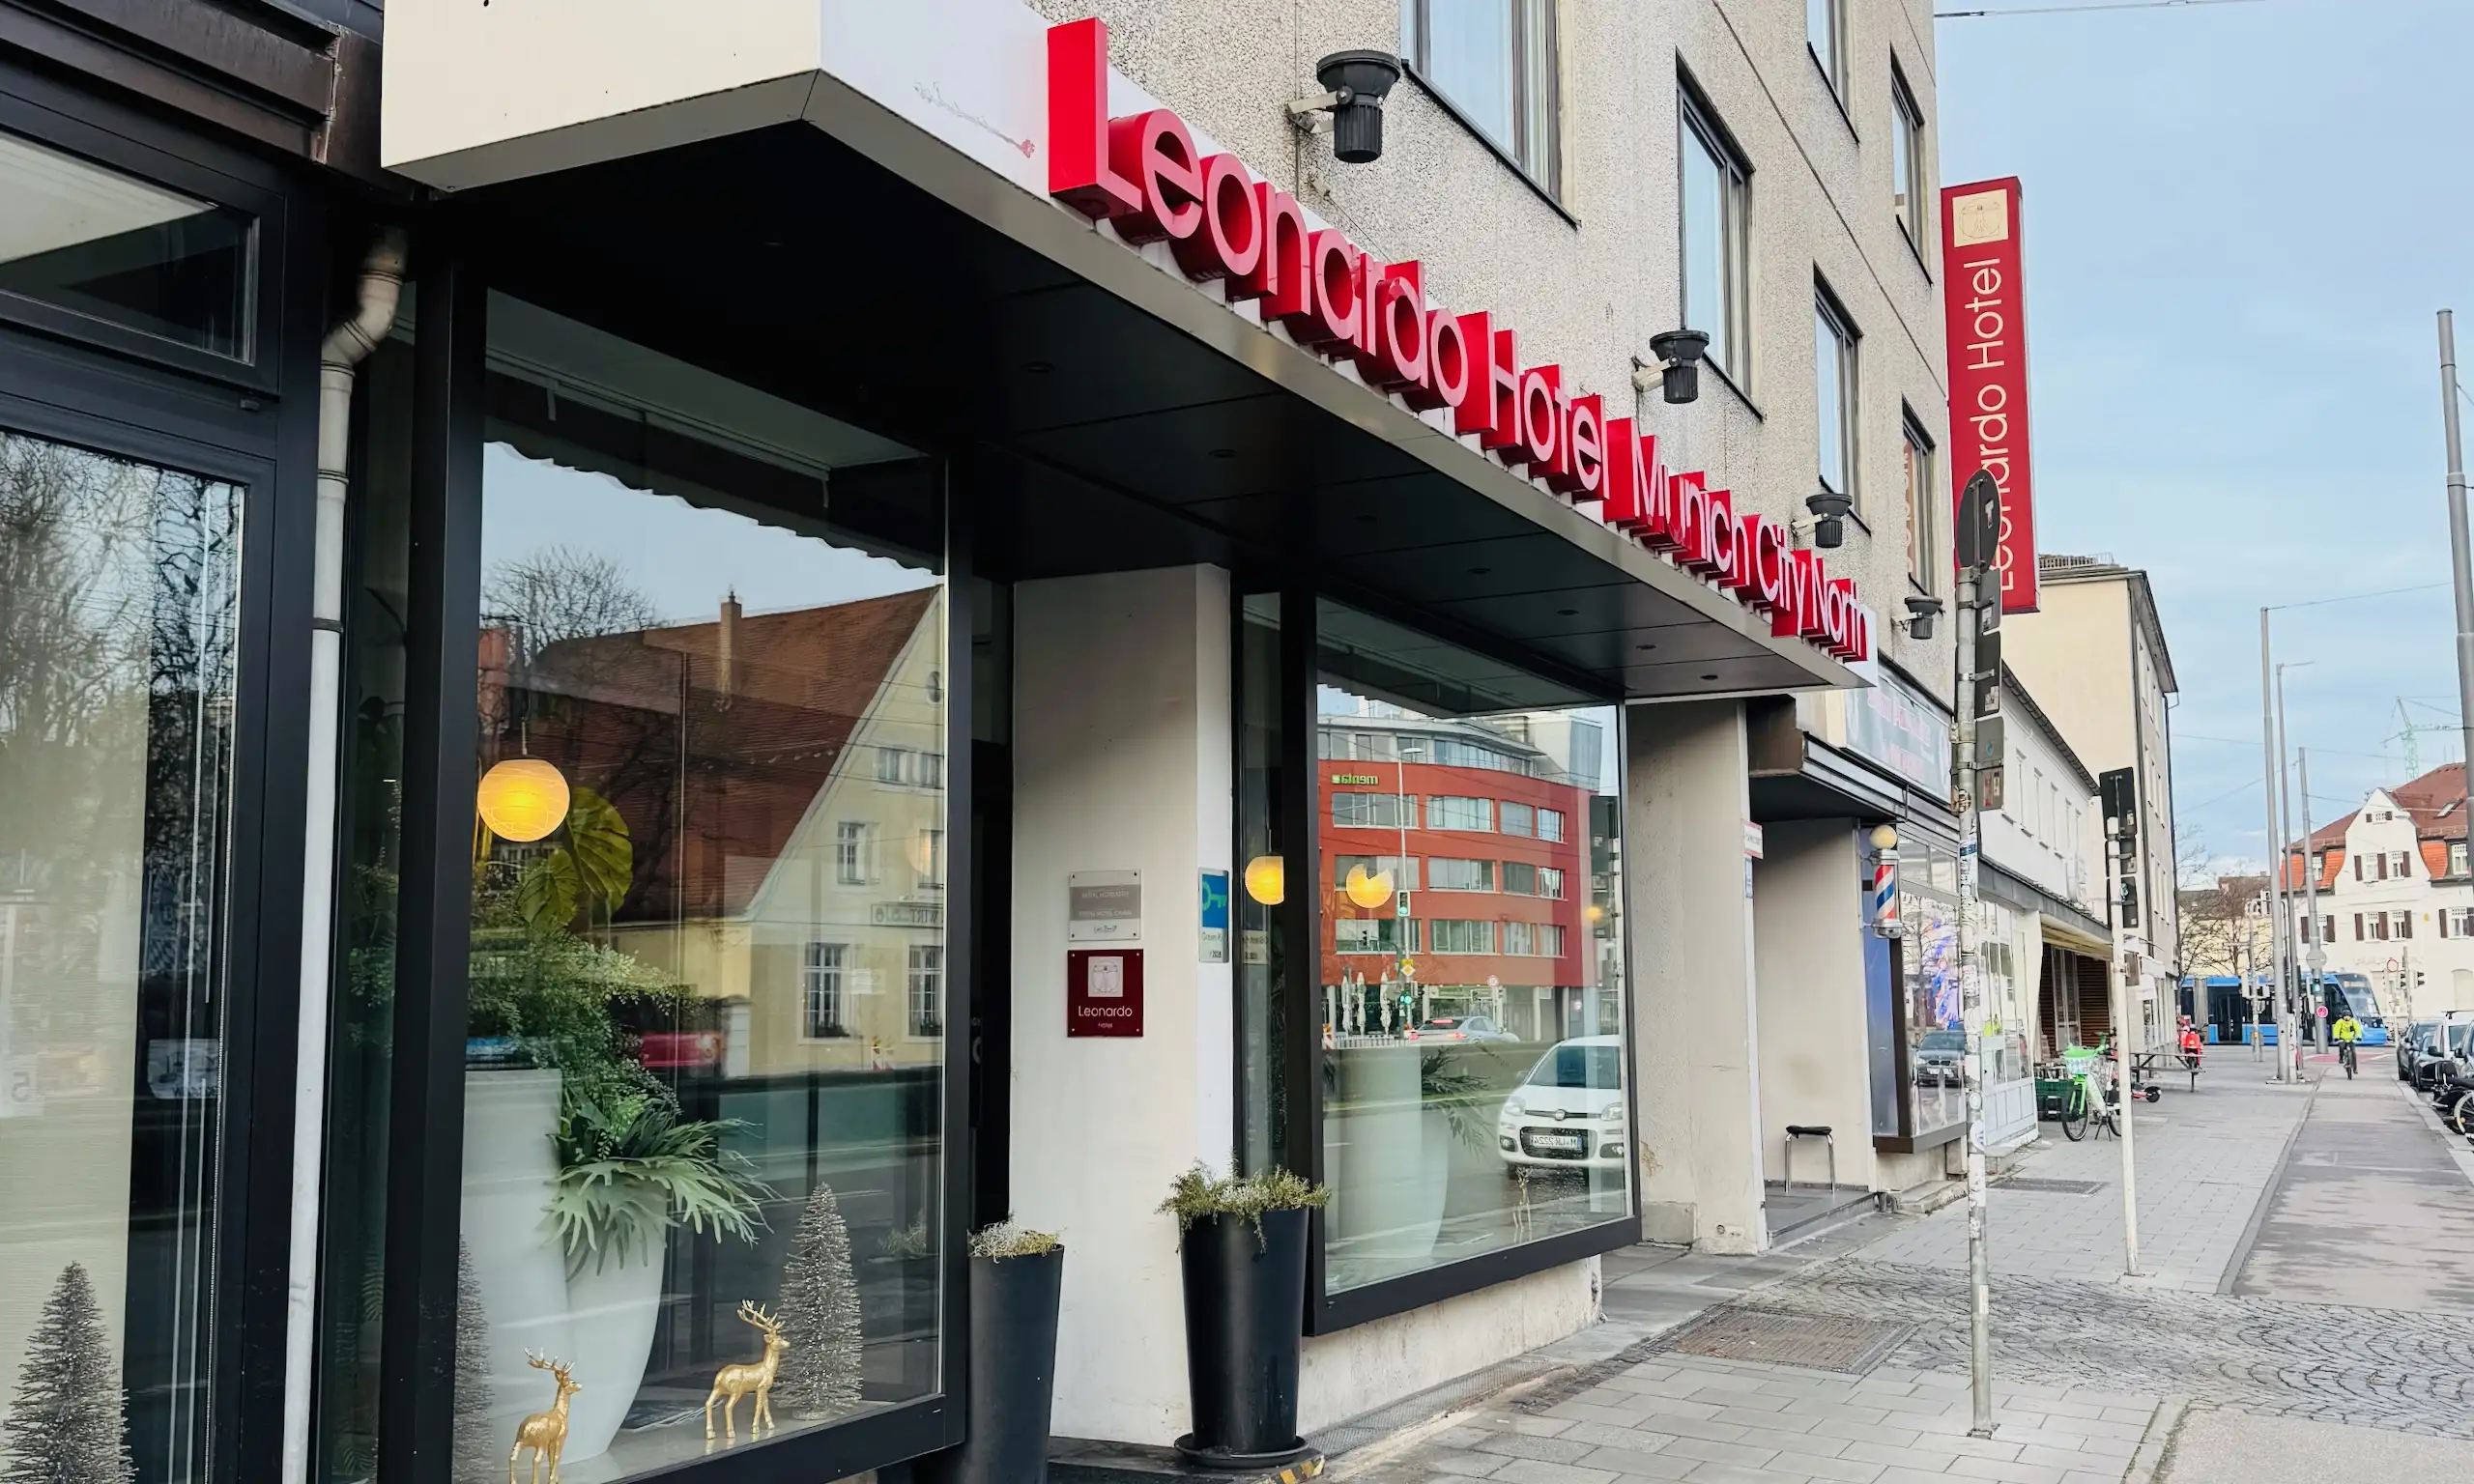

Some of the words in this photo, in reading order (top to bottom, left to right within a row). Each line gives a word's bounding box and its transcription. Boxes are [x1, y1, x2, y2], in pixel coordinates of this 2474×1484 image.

[1048, 17, 1468, 410] Leonardo
[1455, 311, 1609, 501] Hotel
[1604, 417, 1750, 587] Munich
[1737, 513, 1811, 638] City
[1807, 557, 1867, 663] North
[1964, 258, 2005, 371] Hotel
[1078, 1005, 1133, 1017] Leonardo
